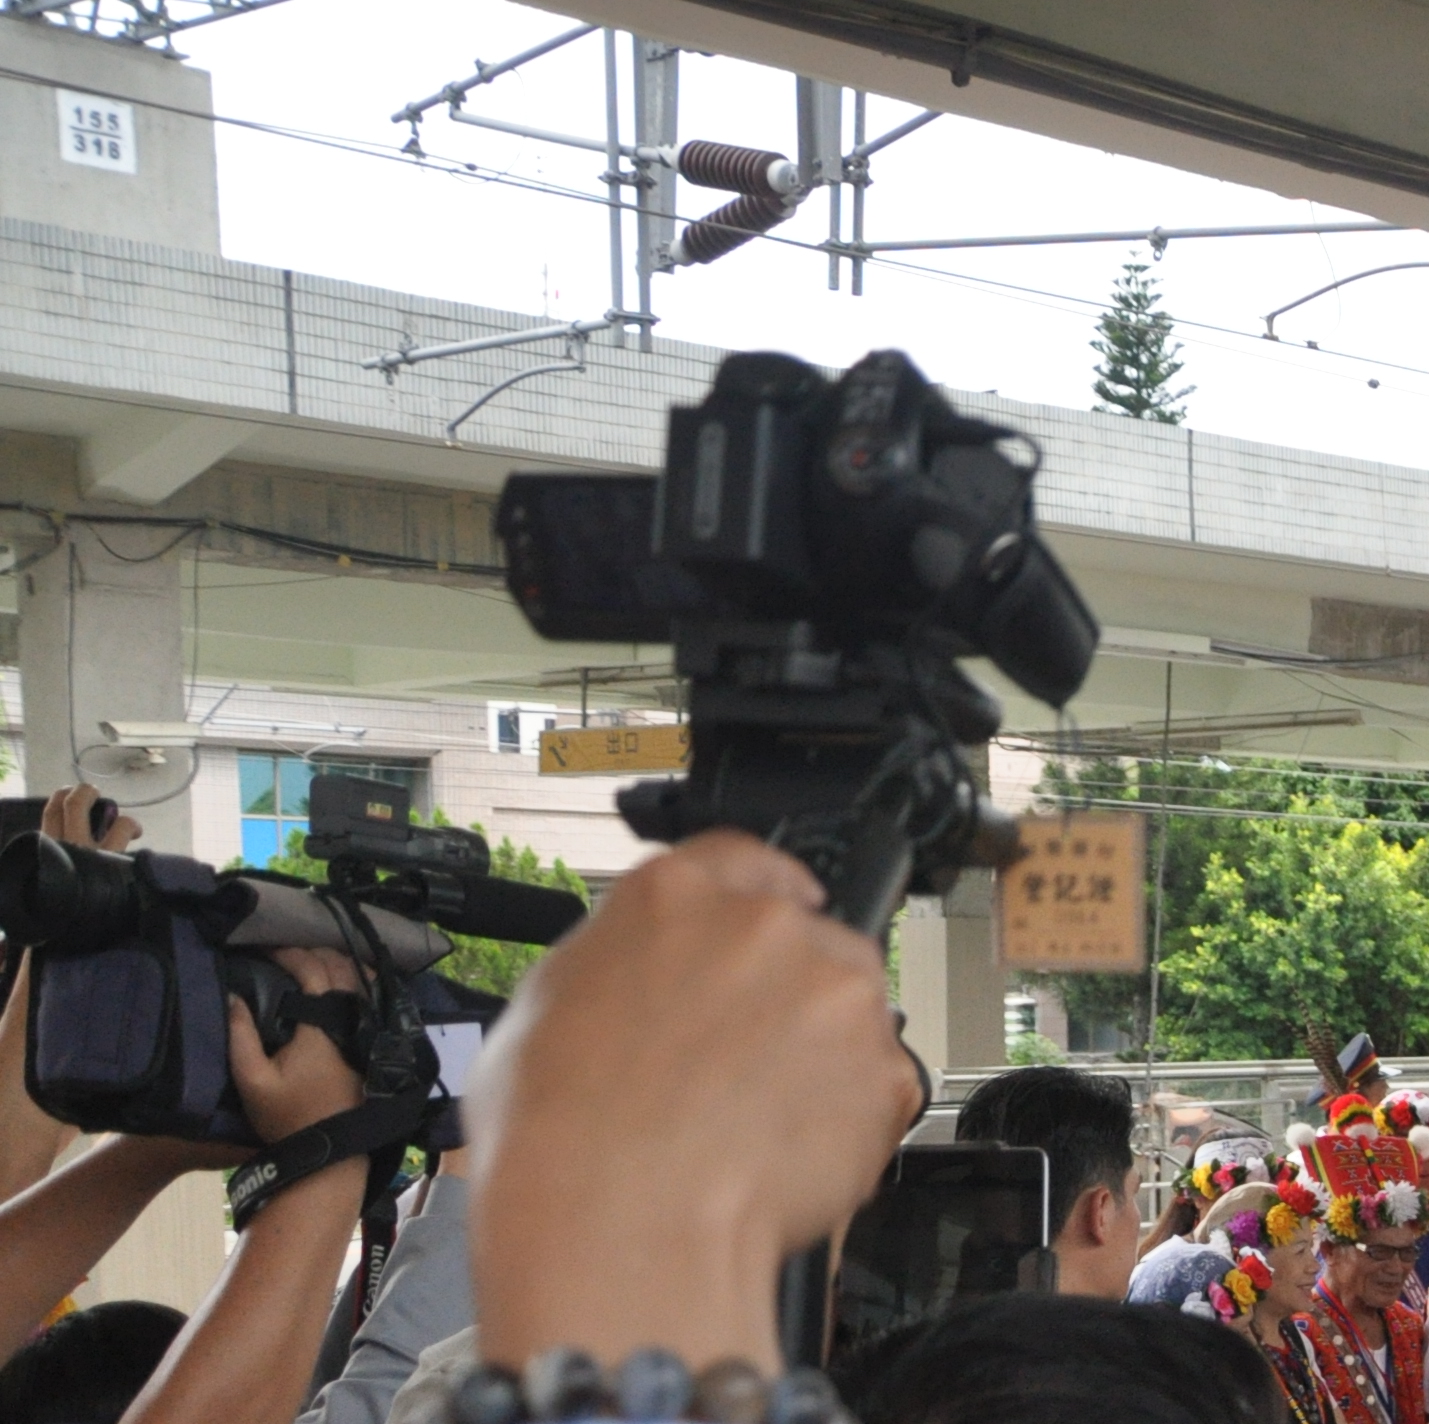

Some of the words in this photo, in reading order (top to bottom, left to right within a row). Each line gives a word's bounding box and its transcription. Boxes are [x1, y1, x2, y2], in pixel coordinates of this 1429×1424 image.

[73, 106, 120, 131] 155
[73, 133, 121, 160] 318
[607, 732, 638, 754] 出口
